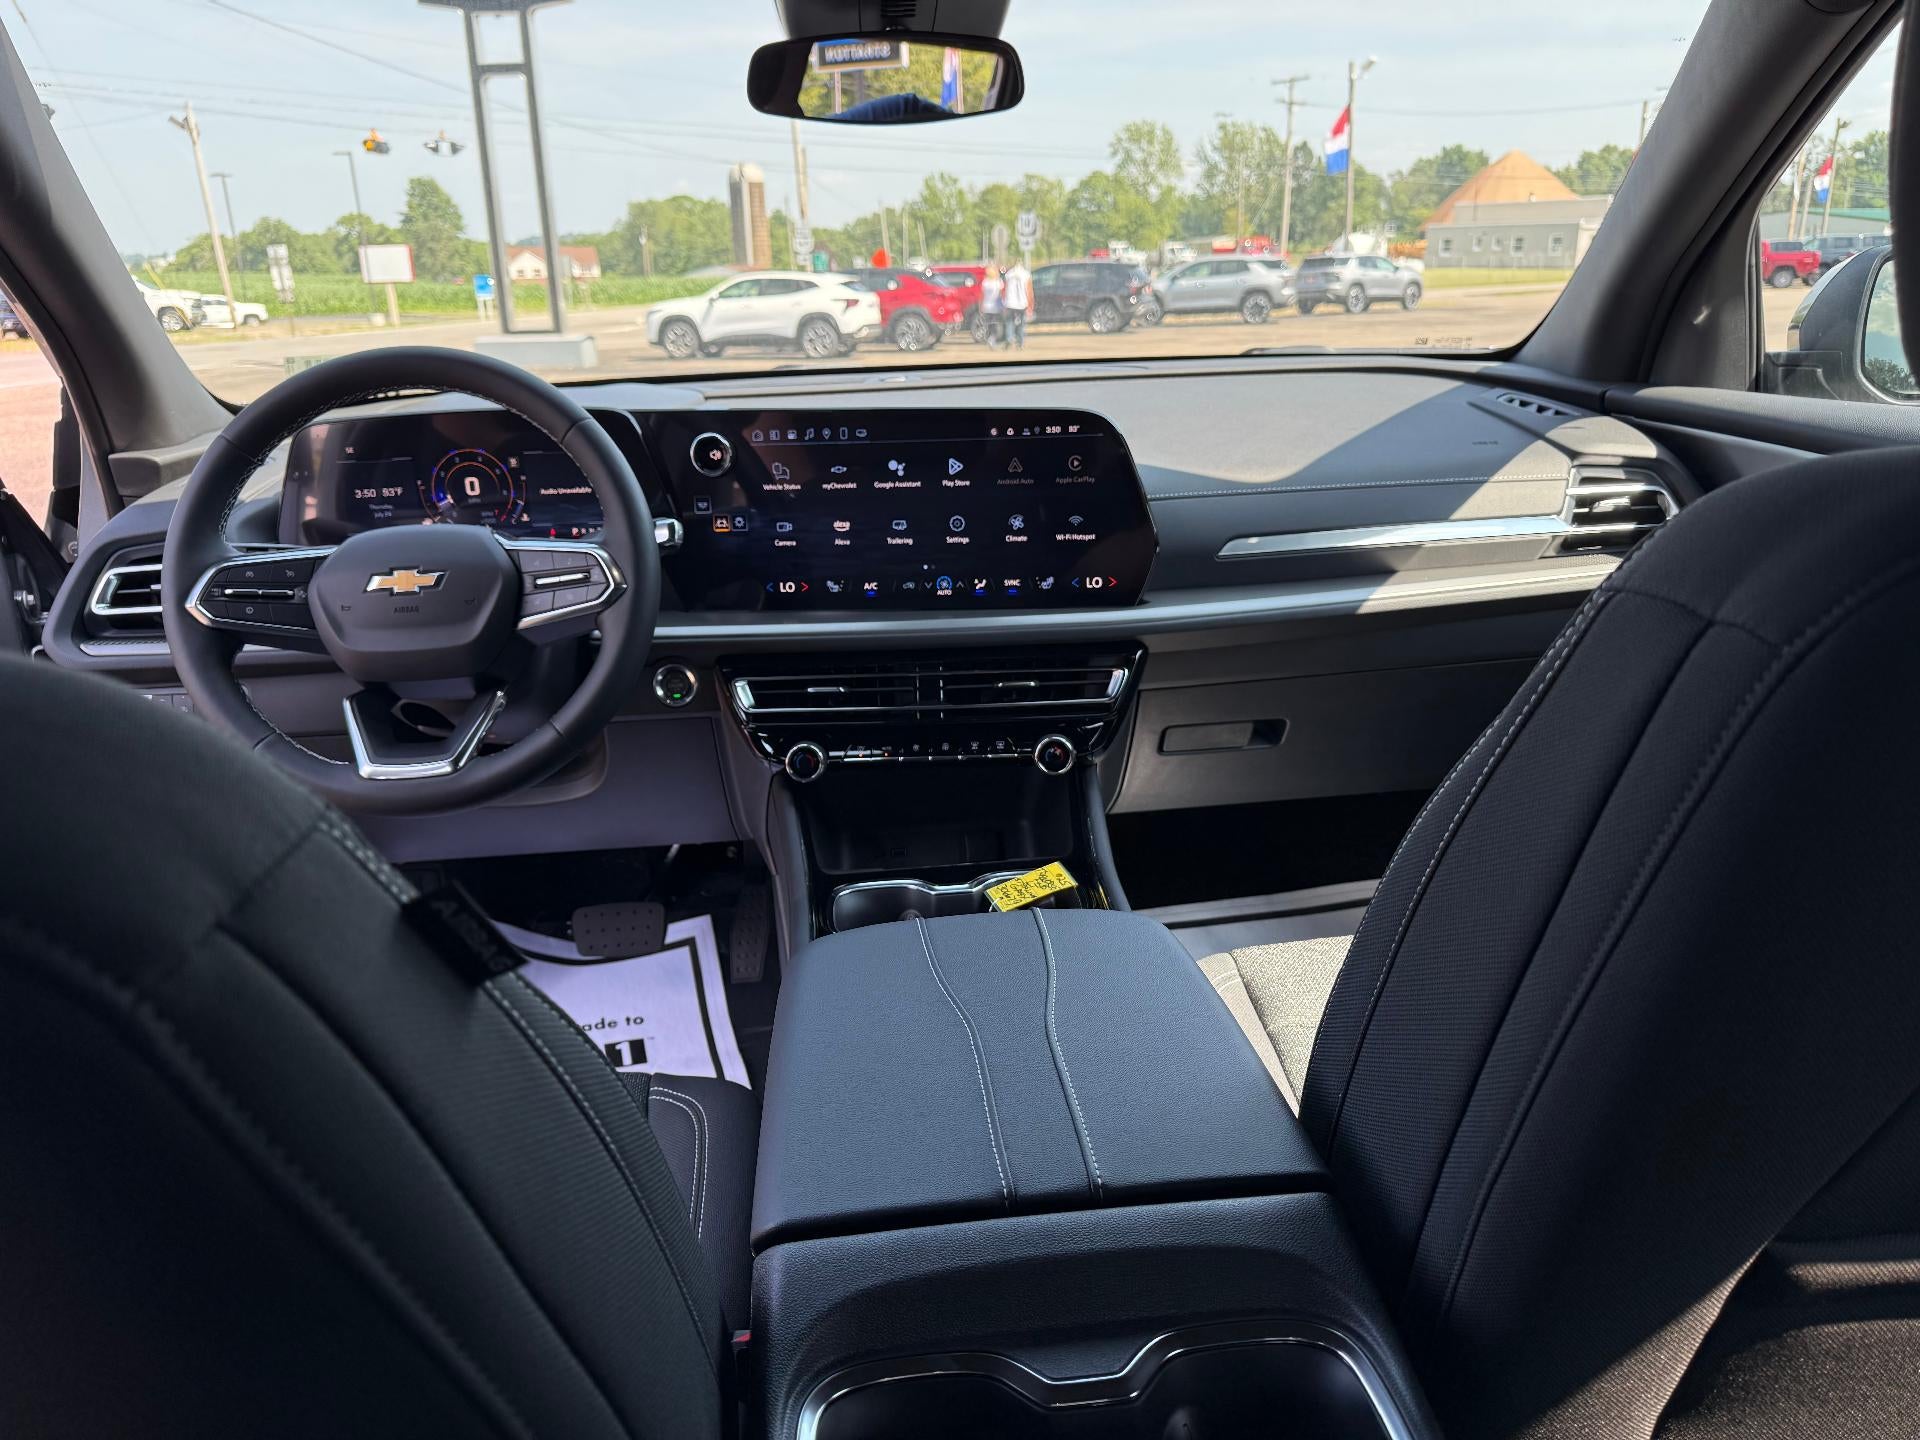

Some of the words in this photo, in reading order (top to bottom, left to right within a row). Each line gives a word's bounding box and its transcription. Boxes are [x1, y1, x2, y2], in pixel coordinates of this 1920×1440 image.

[1045, 426, 1061, 434] 3:50
[874, 481, 894, 489] Google
[895, 480, 921, 488] Assistant
[942, 479, 954, 487] Play
[955, 479, 970, 487] Store
[1074, 476, 1095, 484] CarPlay
[464, 476, 480, 496] 0
[355, 488, 377, 499] 3:50
[887, 537, 913, 546] Trailering
[946, 536, 970, 544] Settings
[1056, 533, 1072, 541] Wi-Fi
[1072, 533, 1095, 542] Hotspot
[774, 539, 796, 547] Camera
[864, 582, 878, 590] A/C
[1004, 579, 1021, 587] SYNC
[1086, 577, 1103, 588] LO
[780, 582, 796, 593] LO
[581, 1017, 617, 1031] ade
[625, 1015, 644, 1026] to
